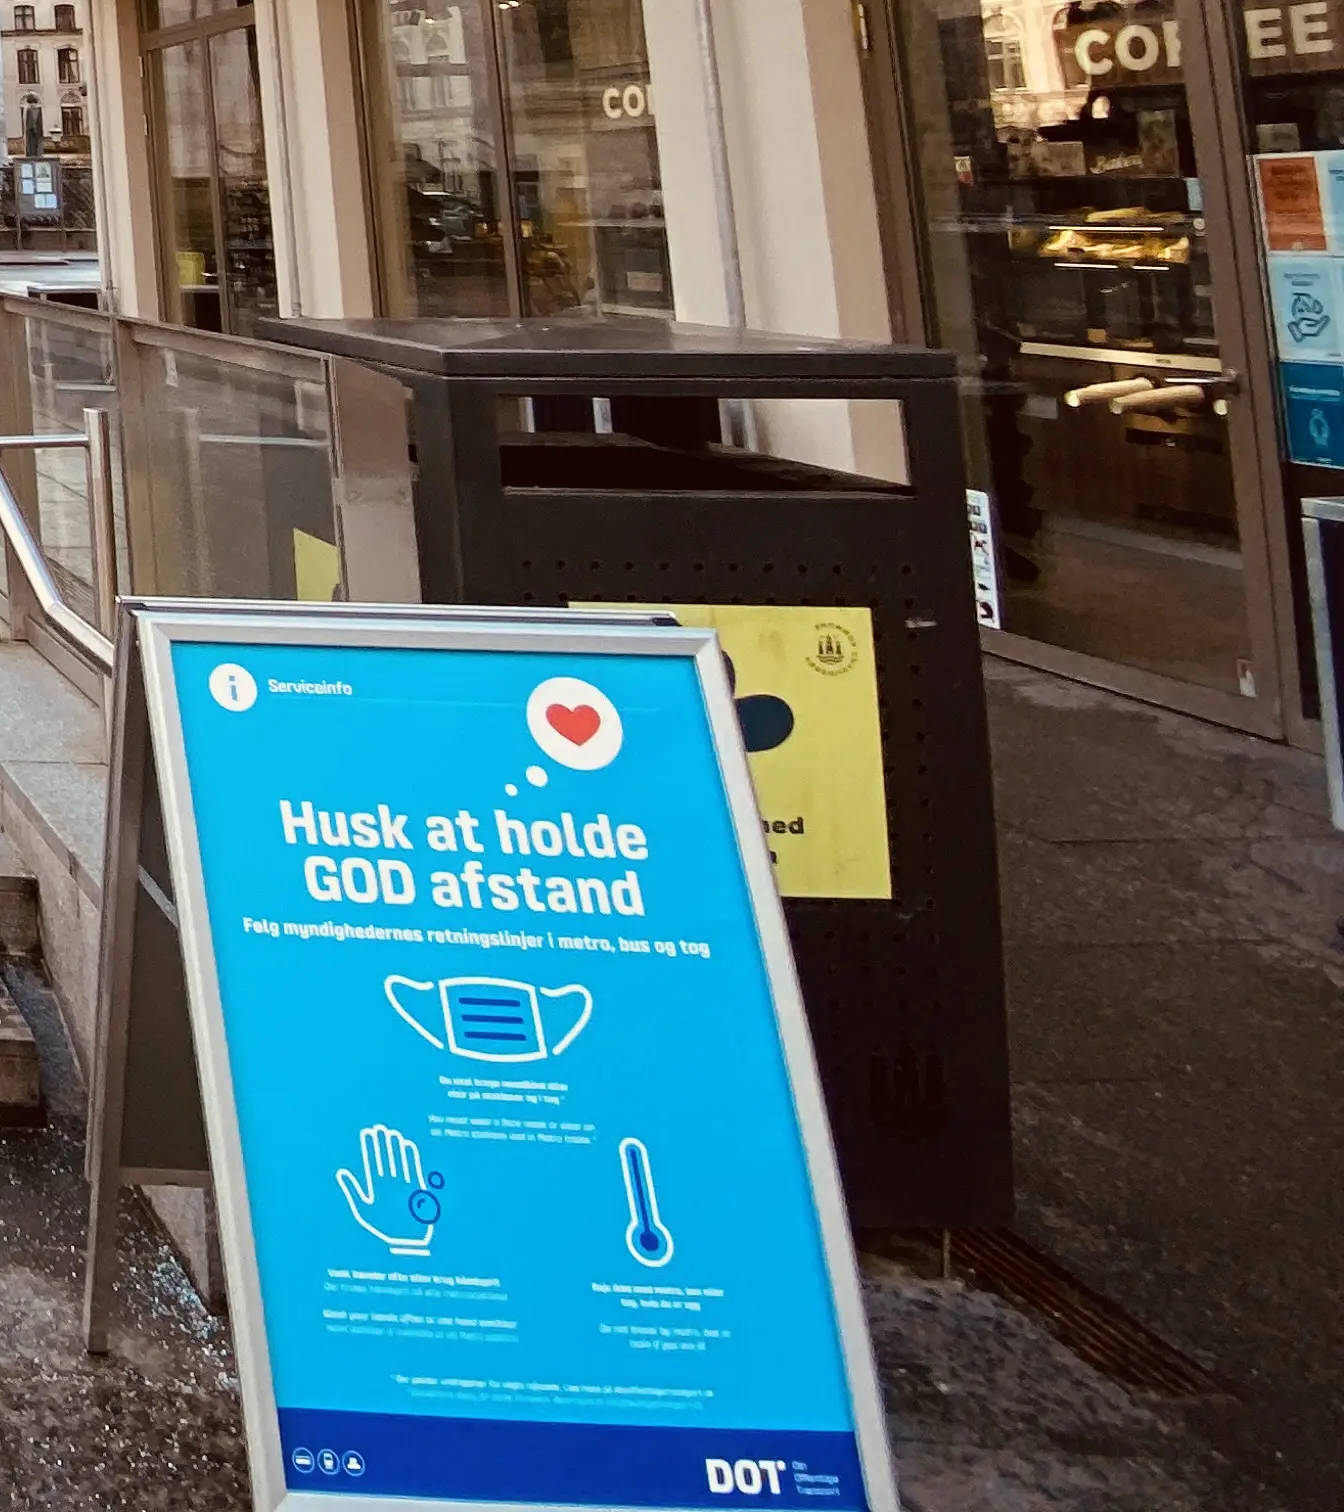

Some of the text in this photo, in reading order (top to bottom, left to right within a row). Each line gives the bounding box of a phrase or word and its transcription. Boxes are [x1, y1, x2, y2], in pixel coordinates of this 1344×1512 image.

[1074, 1, 1334, 76] COEE
[267, 678, 353, 696] Serviceinfo
[279, 799, 649, 861] Husk at holde
[304, 855, 646, 917] GOD afstand
[283, 921, 423, 942] myndighedernes
[427, 928, 543, 950] retningslinjer
[546, 932, 554, 948] i
[558, 934, 616, 952] metro,
[619, 937, 650, 953] bus
[654, 941, 677, 957] og
[679, 940, 711, 958] tog
[705, 1458, 787, 1495] DOT
